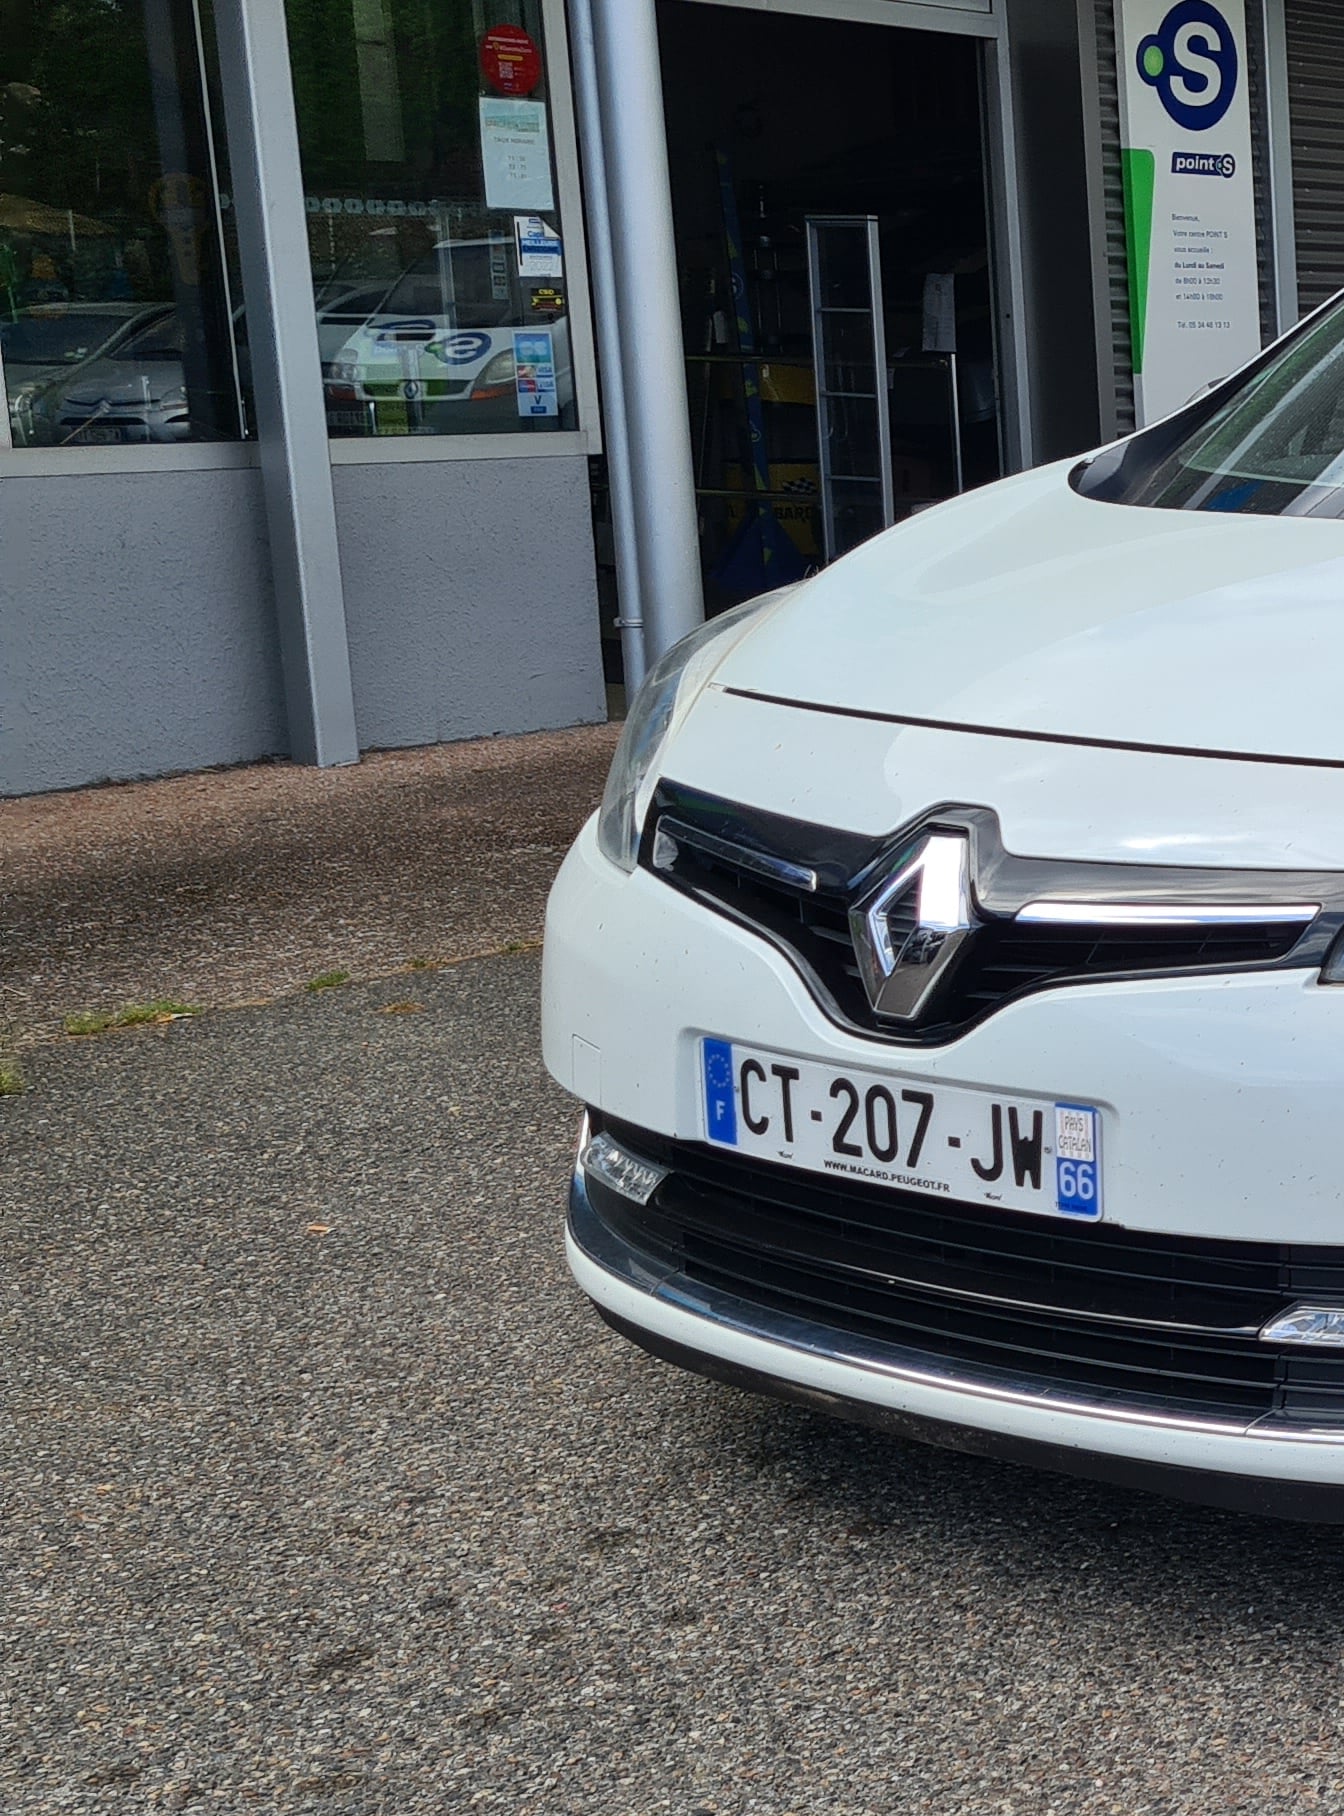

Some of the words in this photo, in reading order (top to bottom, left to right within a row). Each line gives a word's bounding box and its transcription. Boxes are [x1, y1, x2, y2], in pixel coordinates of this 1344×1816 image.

[1170, 21, 1222, 107] S
[1176, 156, 1215, 171] point
[1222, 157, 1233, 175] S
[715, 1101, 726, 1121] F
[741, 1059, 1044, 1190] CT-207-JW
[1064, 1115, 1084, 1132] PAYS
[1058, 1134, 1092, 1153] CATALAN
[1059, 1161, 1094, 1201] 66
